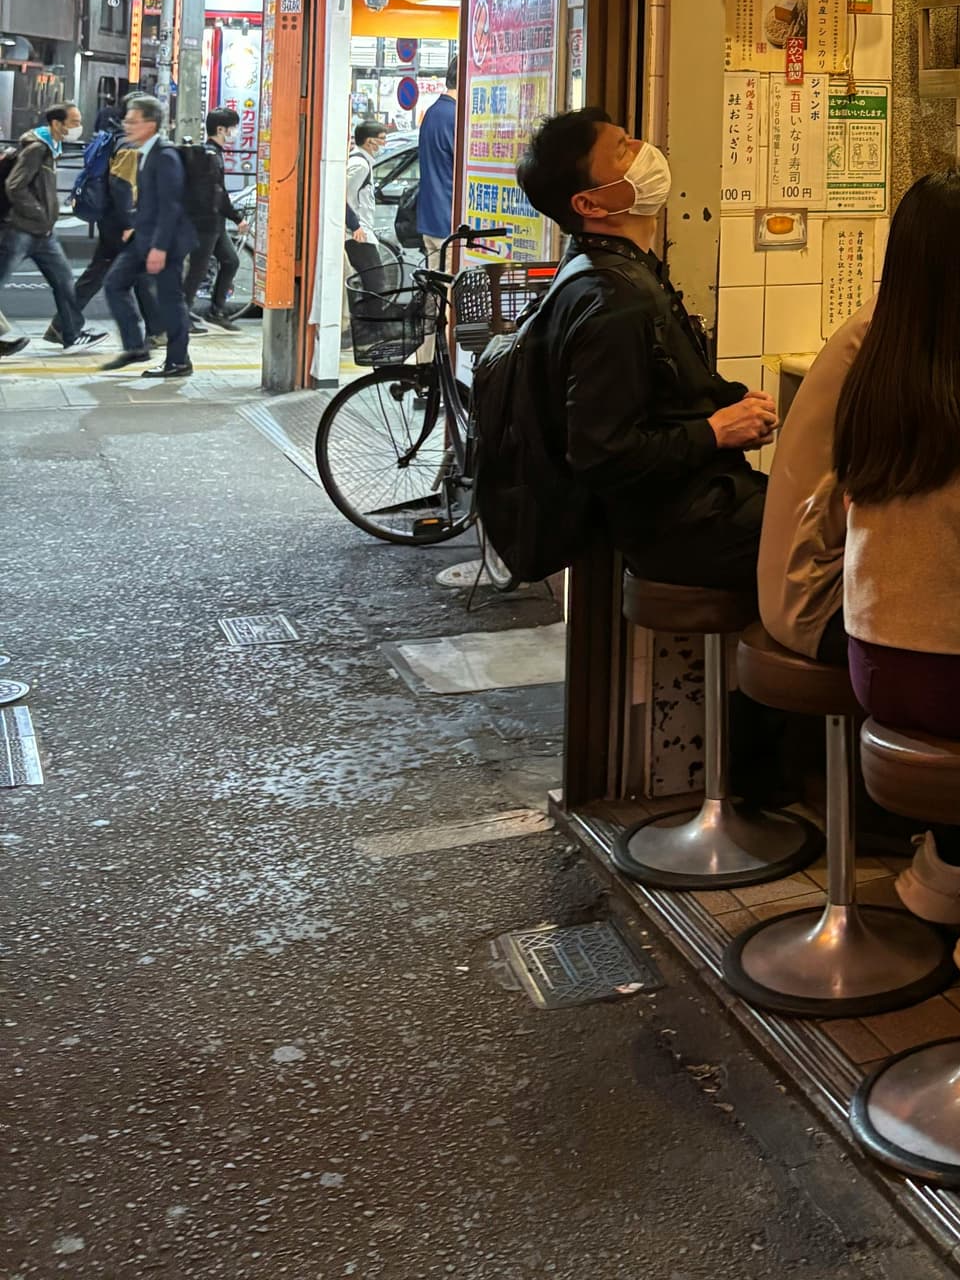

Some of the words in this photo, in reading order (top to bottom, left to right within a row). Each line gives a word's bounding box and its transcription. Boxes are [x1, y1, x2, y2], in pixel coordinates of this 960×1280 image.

[727, 93, 741, 166] 鮭おにぎり
[810, 78, 820, 121] ジャンボ
[788, 90, 802, 185] 五目いなり寿司
